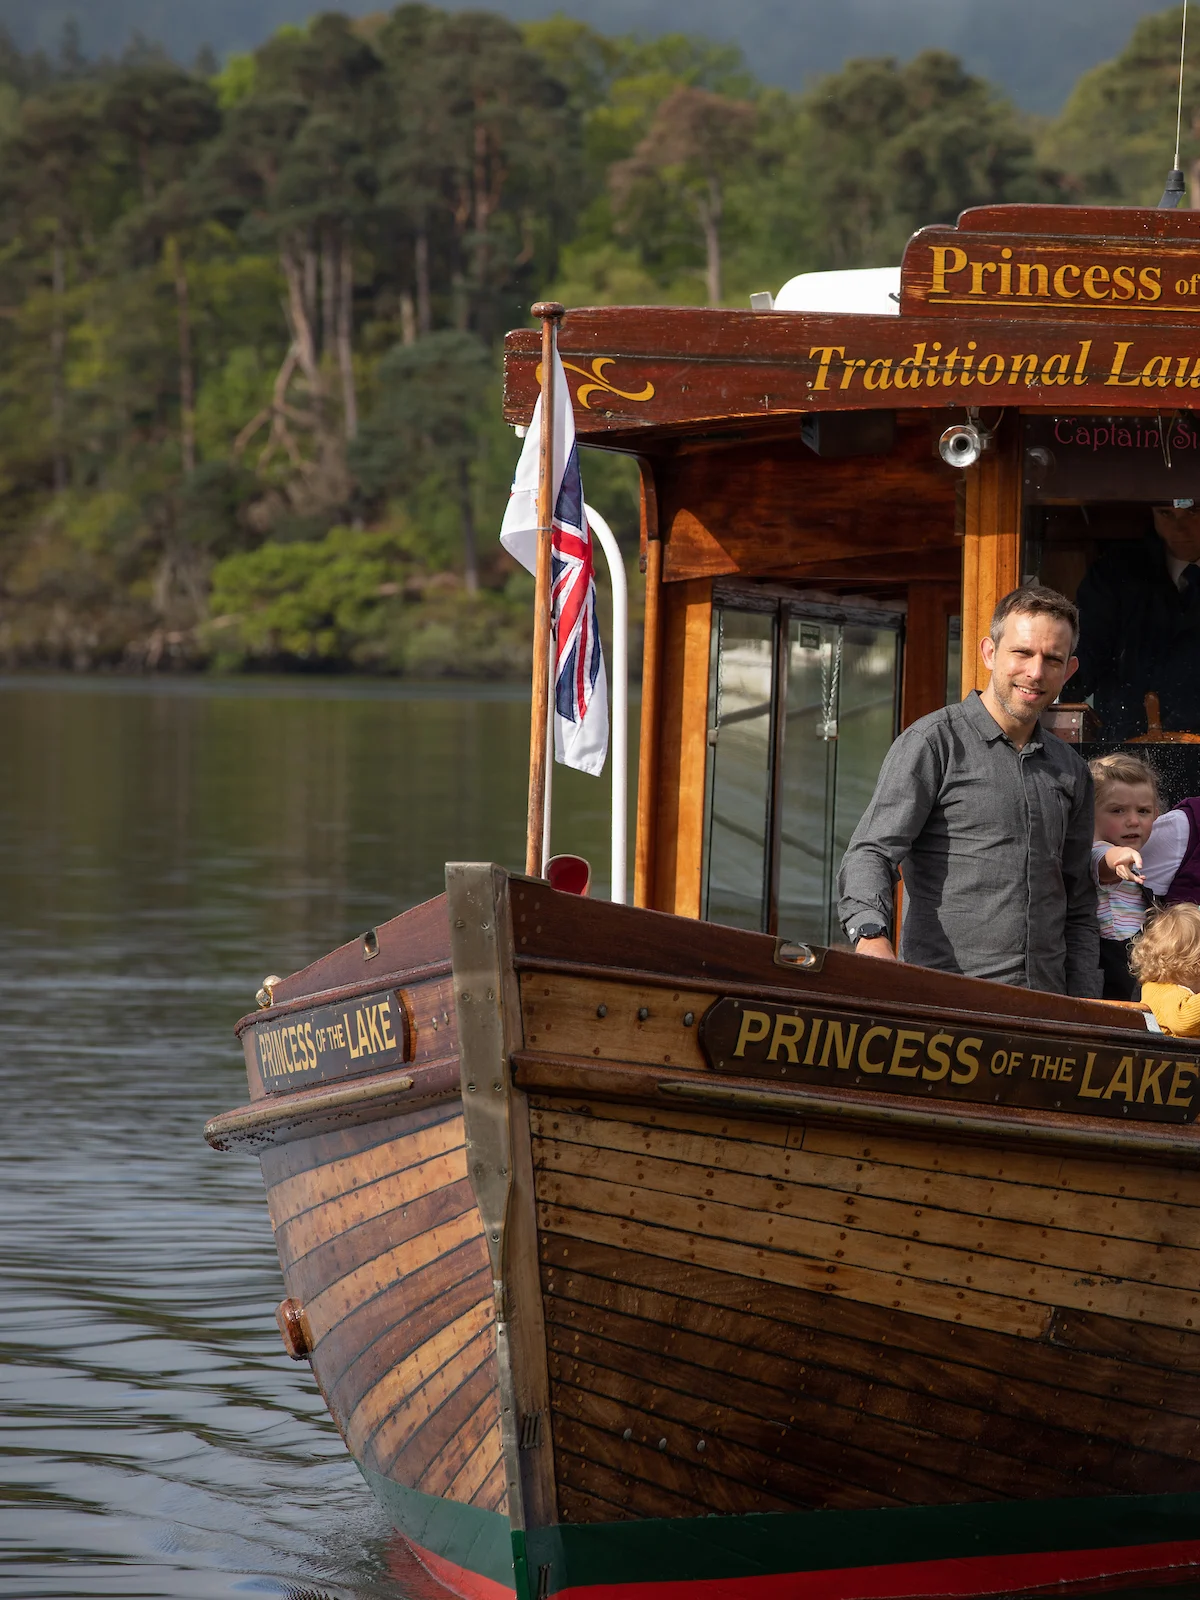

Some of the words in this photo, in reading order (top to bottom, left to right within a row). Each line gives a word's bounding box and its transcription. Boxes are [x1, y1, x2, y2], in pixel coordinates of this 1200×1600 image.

[928, 245, 1163, 301] Princess
[1175, 273, 1200, 296] of
[808, 339, 1093, 391] Traditional
[1055, 417, 1160, 450] Captain
[258, 1022, 317, 1078] PRINCESS
[315, 1028, 326, 1053] OF
[327, 1023, 345, 1050] THE
[343, 1002, 396, 1059] LAKE
[733, 1009, 984, 1086] PRINCESS
[989, 1049, 1022, 1076] OF
[1030, 1053, 1077, 1082] THE
